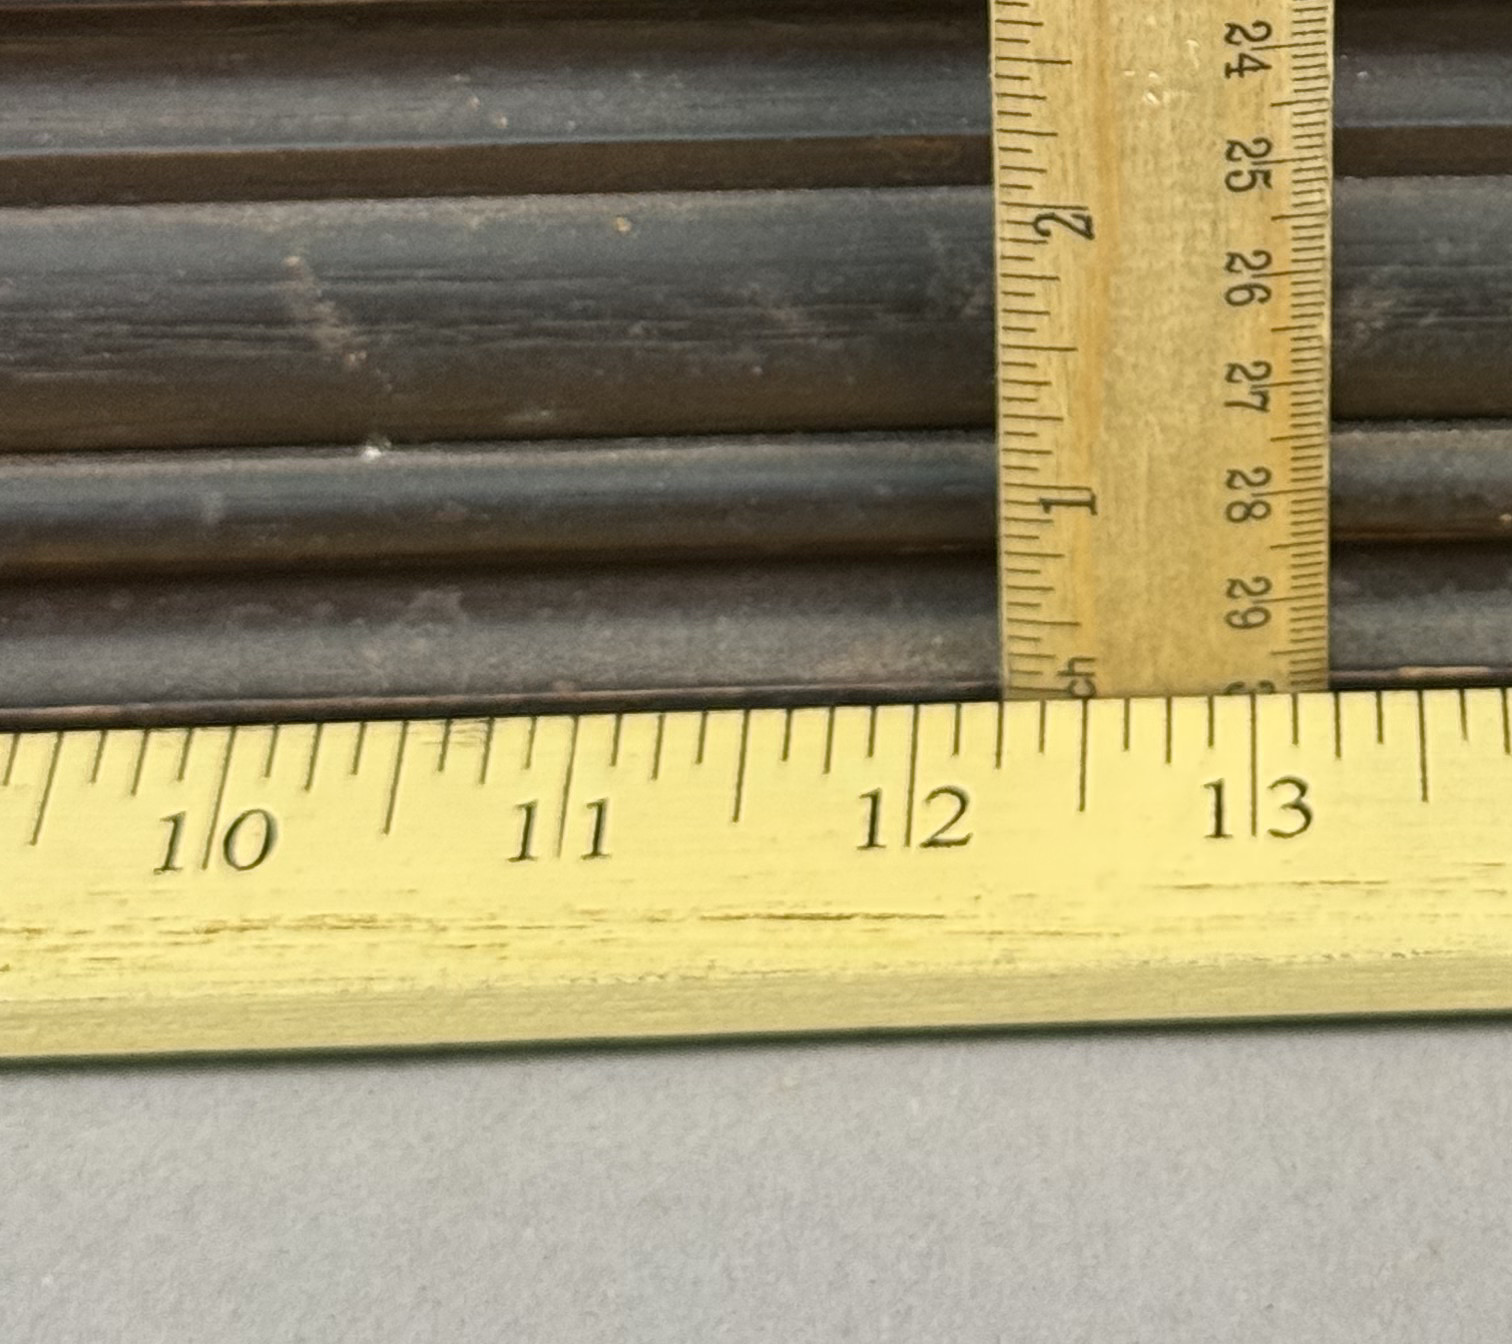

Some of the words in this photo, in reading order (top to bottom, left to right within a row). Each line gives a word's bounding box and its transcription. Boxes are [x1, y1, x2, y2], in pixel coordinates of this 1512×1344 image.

[1223, 20, 1273, 79] 24
[1224, 137, 1274, 193] 25
[1032, 212, 1095, 242] 2
[1223, 250, 1273, 307] 26
[1224, 360, 1272, 414] 27
[1039, 488, 1098, 517] 1
[1224, 466, 1272, 524] 28
[1224, 575, 1272, 631] 29
[152, 808, 280, 874] 10
[508, 798, 613, 864] 11
[855, 784, 974, 852] 12
[1203, 775, 1315, 841] 13
